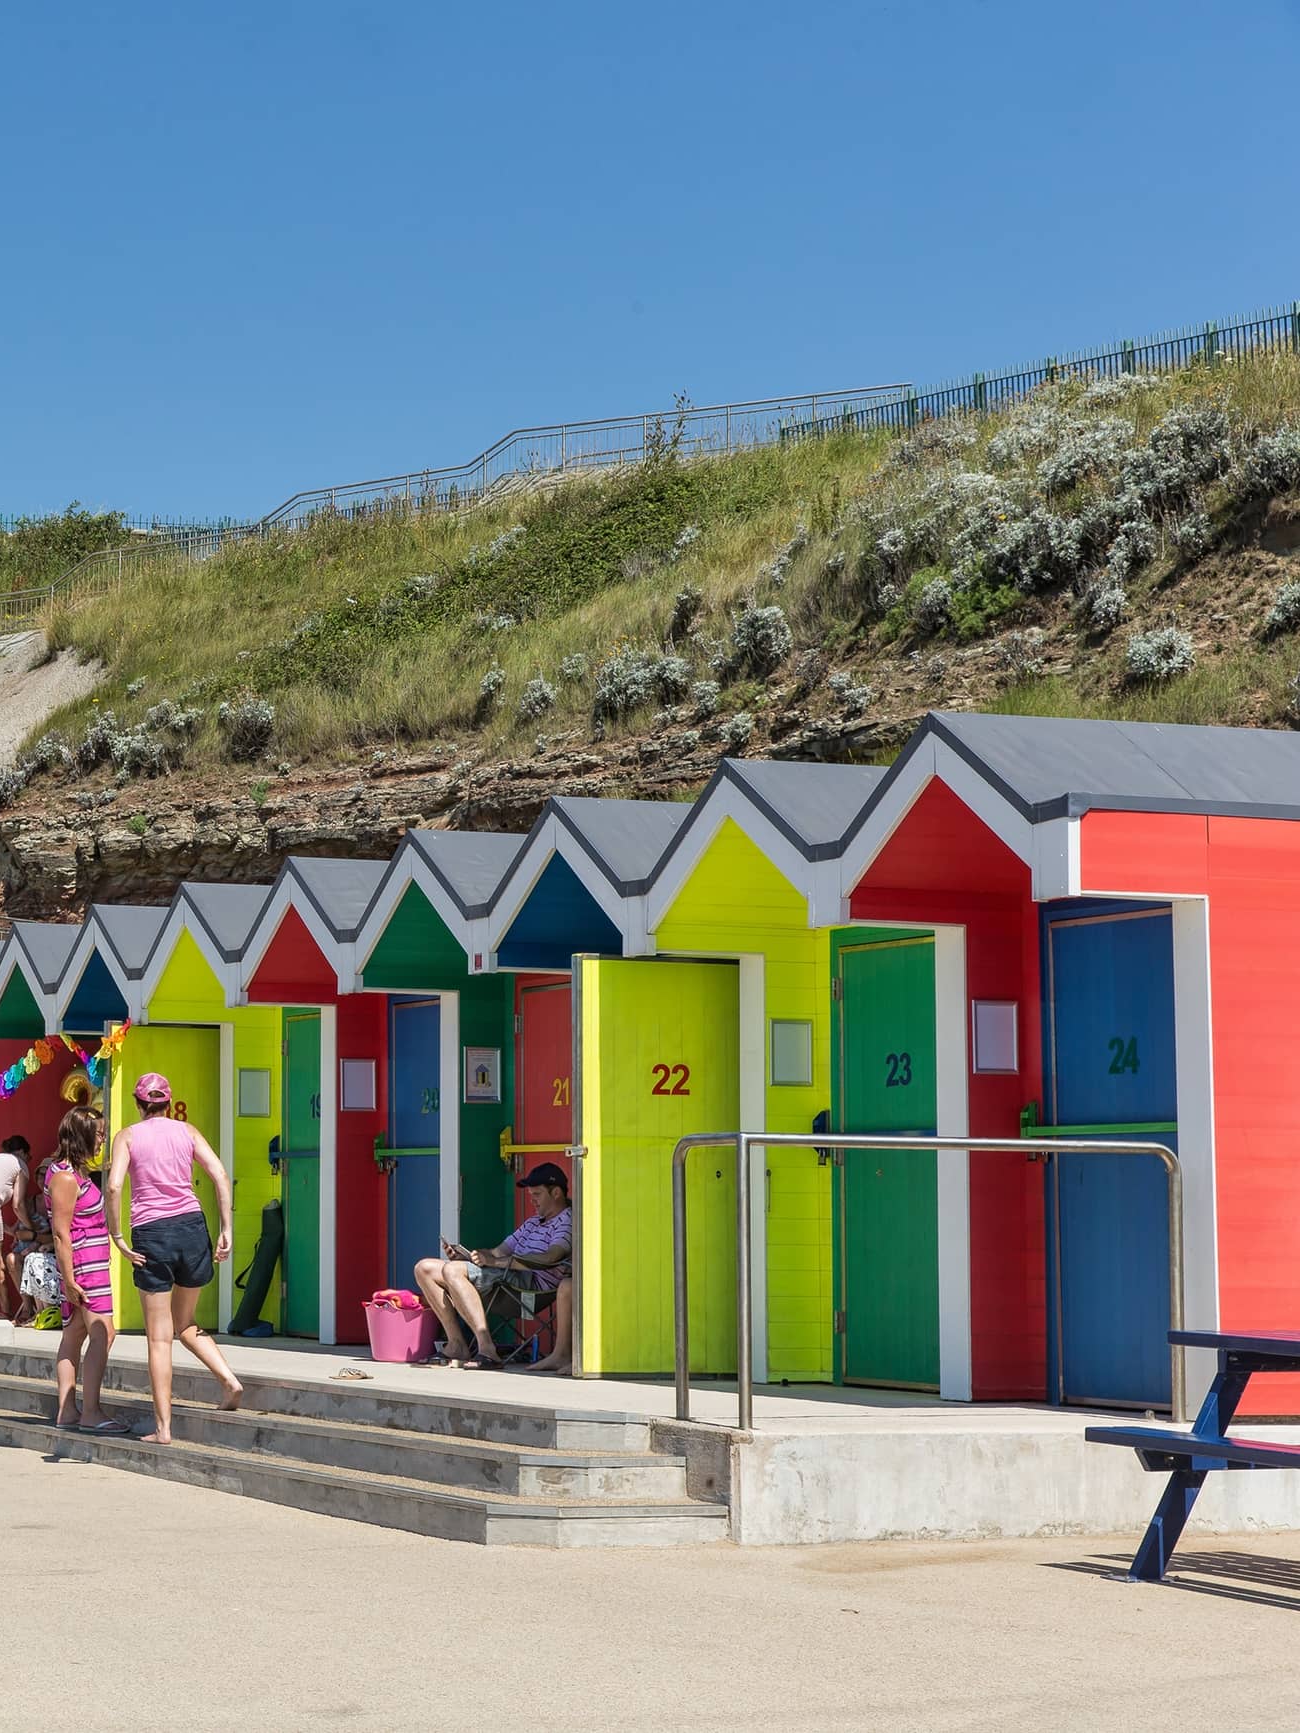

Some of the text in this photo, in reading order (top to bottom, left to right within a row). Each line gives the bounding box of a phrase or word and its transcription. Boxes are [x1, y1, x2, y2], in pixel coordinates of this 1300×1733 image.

[886, 1052, 912, 1087] 23
[1108, 1036, 1140, 1074] 24
[552, 1077, 570, 1105] 21
[652, 1063, 690, 1096] 22
[420, 1088, 439, 1113] 20
